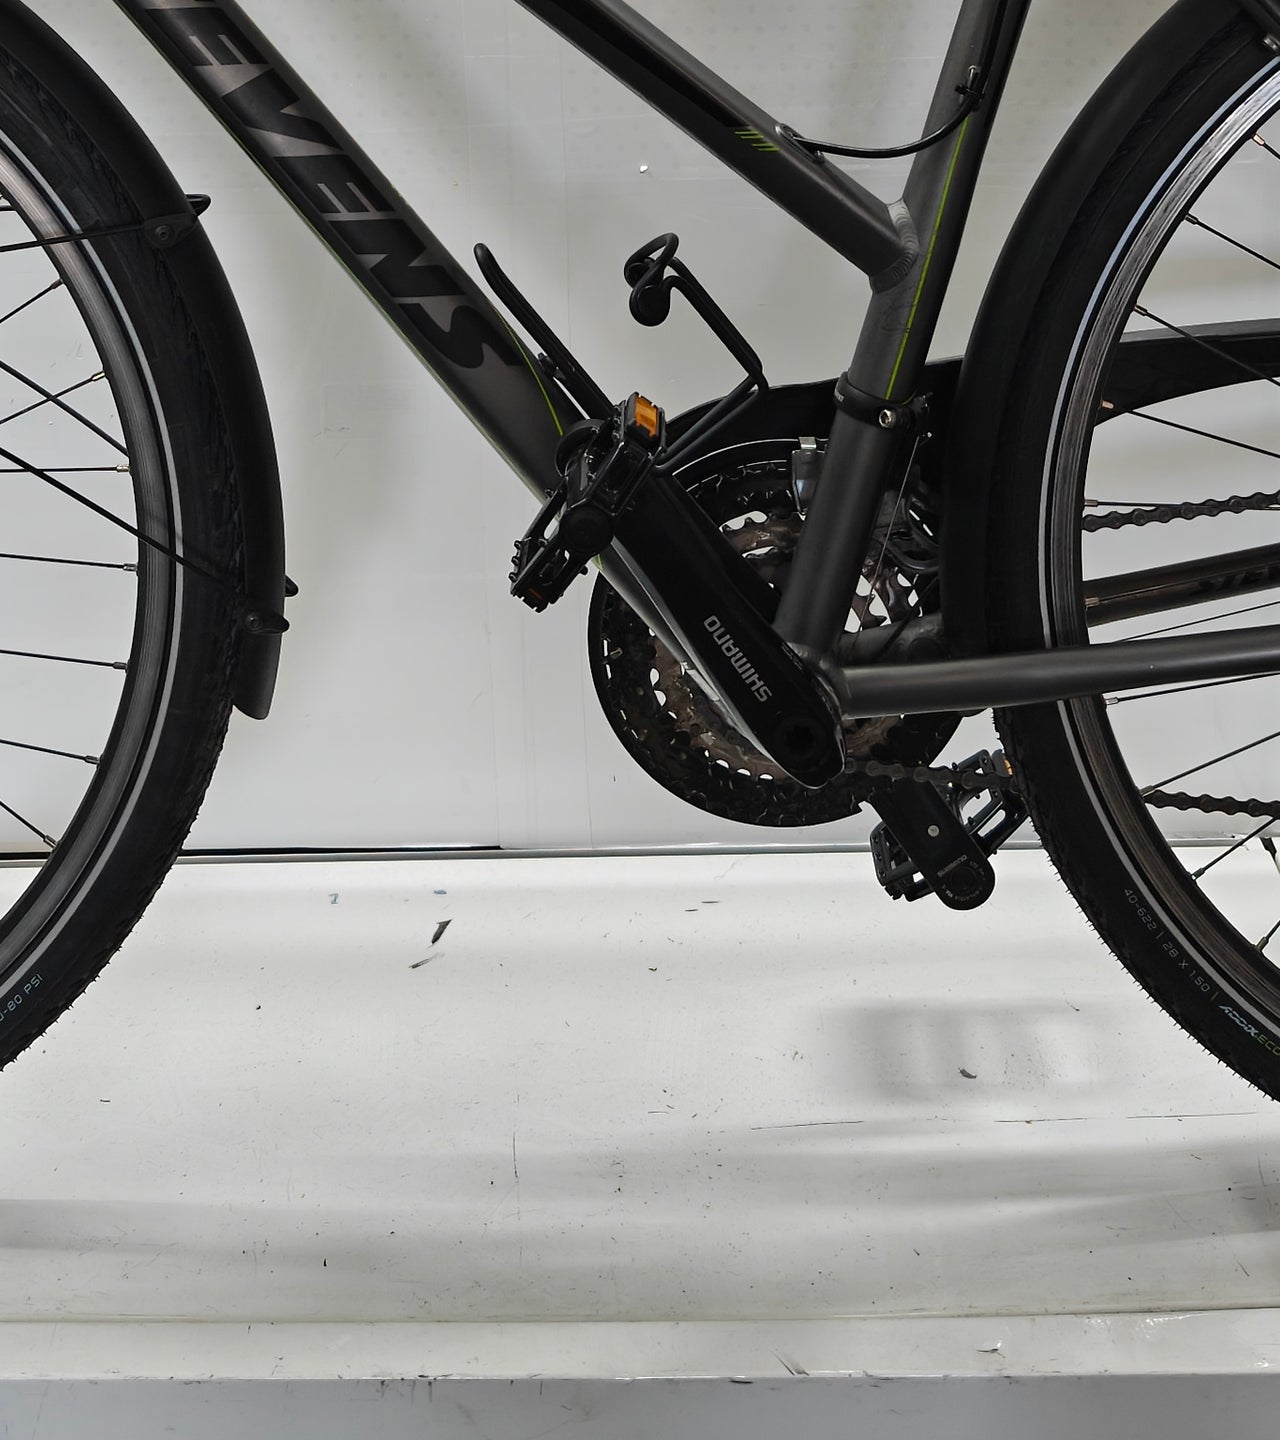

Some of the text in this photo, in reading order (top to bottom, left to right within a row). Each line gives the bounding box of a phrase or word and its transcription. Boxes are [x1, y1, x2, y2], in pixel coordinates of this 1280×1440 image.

[703, 615, 773, 702] SHIMANO
[1124, 888, 1157, 930] 40-622
[1162, 941, 1179, 958] 28
[23, 973, 44, 996] PSI
